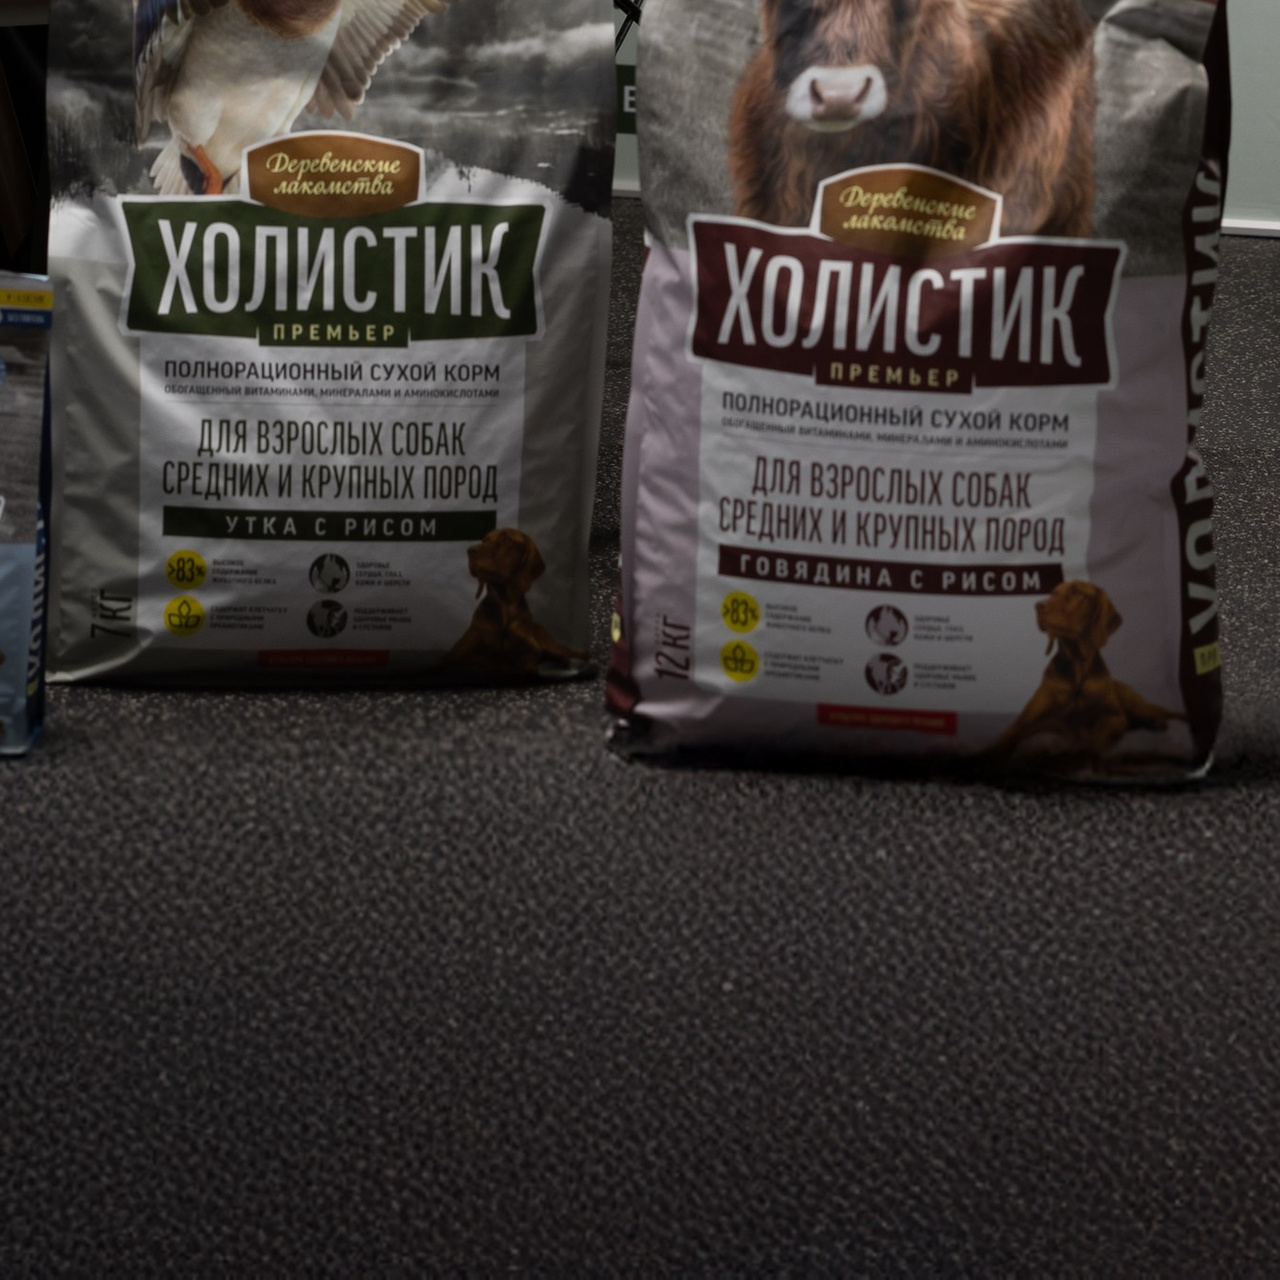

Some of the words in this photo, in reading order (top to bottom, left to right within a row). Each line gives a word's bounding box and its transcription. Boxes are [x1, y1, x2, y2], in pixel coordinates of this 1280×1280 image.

[266, 153, 402, 184] Деревенские
[273, 174, 394, 197] лакомства
[839, 185, 976, 220] Деревенские
[842, 210, 966, 240] лакомства
[157, 219, 511, 320] ХОЛИСТИК
[717, 242, 1085, 368] ХОЛИСТИК
[273, 323, 396, 342] ПРЕМЬЕР
[164, 360, 362, 382] ПОЛНОРАЦИОННЫЙ
[370, 361, 436, 382] СУХОЙ
[445, 364, 500, 382] КОРМ
[830, 362, 961, 387] ПРЕМЬЕР
[164, 384, 242, 396] ОБОГАЩЕННЫЙ
[320, 388, 391, 398] МИНЕРАЛАМИ
[394, 388, 401, 398] И
[404, 388, 500, 399] АМИНОКИСЛОТАМИ
[722, 391, 923, 427] ПОЛНОРАЦИОННЫЙ
[930, 407, 1001, 430] СУХОЙ
[1009, 412, 1069, 432] КОРМ
[197, 419, 248, 457] ДЛЯ
[257, 420, 382, 456] ВЗРОСЛЫХ
[391, 422, 466, 456] СОБАК
[162, 460, 268, 501] СРЕДНИХ
[278, 465, 293, 497] И
[302, 464, 414, 500] КРУПНЫХ
[424, 465, 498, 503] ПОРОД
[752, 455, 800, 496] ДЛЯ
[810, 463, 942, 508] ВЗРОСЛЫХ
[952, 472, 1031, 509] СОБАК
[225, 516, 297, 536] УТКА
[314, 517, 327, 536] С
[345, 516, 438, 537] РИСОМ
[719, 497, 821, 544] СРЕДНИХ
[831, 510, 846, 544] И
[856, 511, 976, 553] КРУПНЫХ
[985, 517, 1065, 556] ПОРОД
[168, 557, 205, 583] >83%
[740, 556, 892, 588] ГОВЯДИНА
[910, 569, 924, 588] С
[942, 570, 1041, 591] РИСОМ
[99, 588, 132, 621] КГ
[91, 623, 132, 639] 7
[662, 614, 690, 649] КГ
[655, 651, 689, 680] 12
